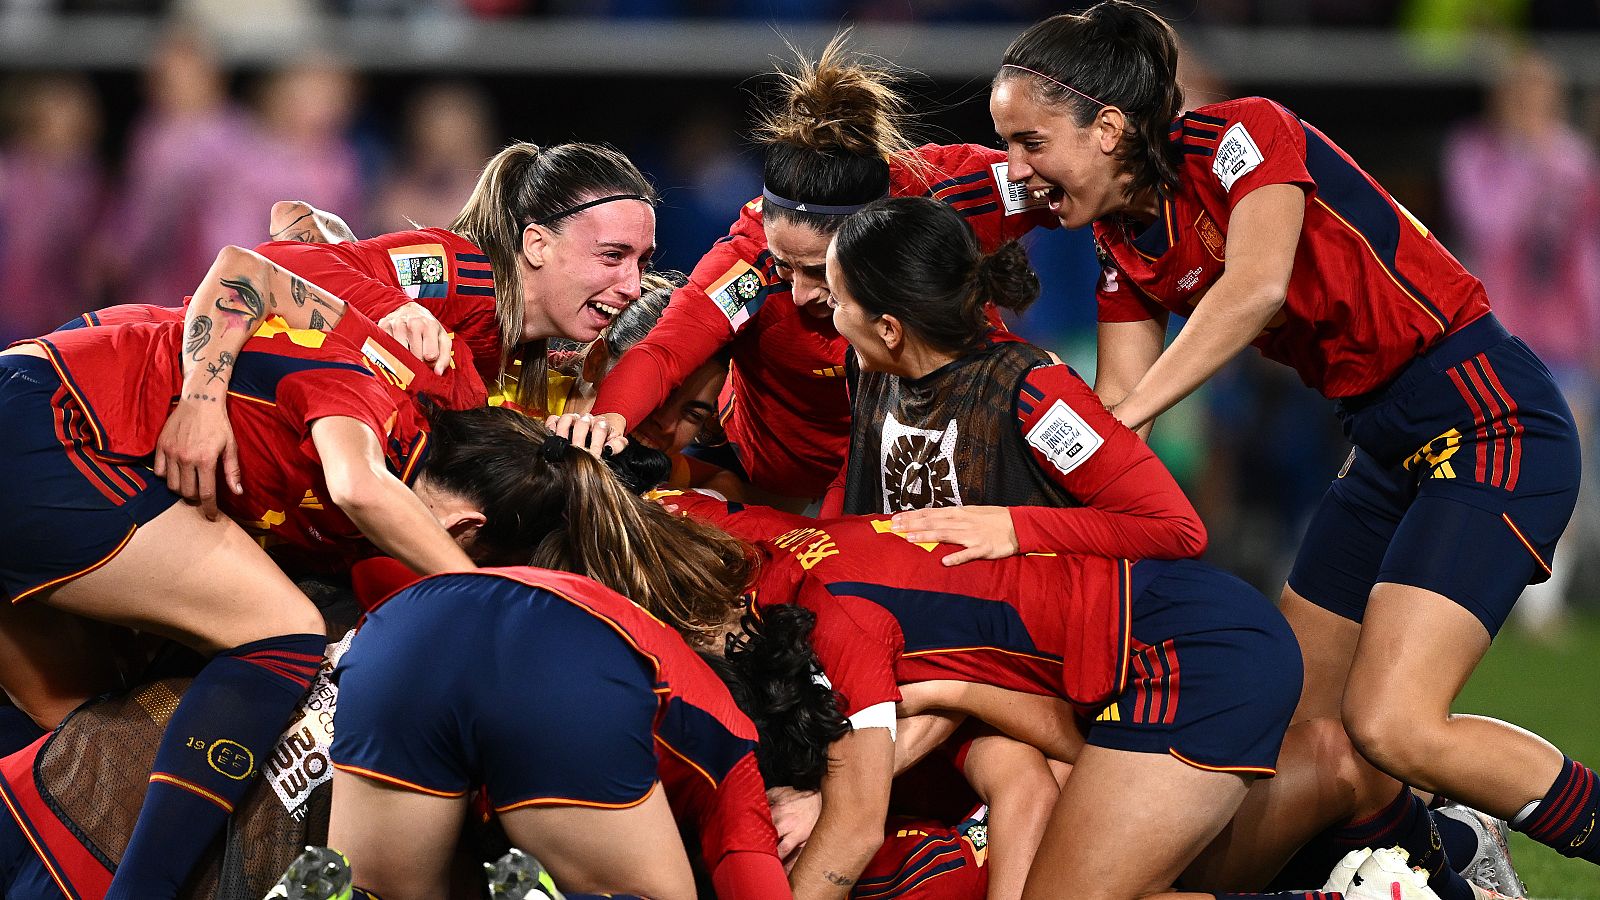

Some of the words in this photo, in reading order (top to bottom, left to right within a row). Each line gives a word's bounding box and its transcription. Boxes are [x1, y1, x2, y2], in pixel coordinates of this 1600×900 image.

[1217, 136, 1238, 159] OOTBALL
[1039, 416, 1065, 443] FOOTBALL
[1045, 422, 1073, 450] UNITES
[1053, 446, 1065, 456] the
[1061, 428, 1082, 449] World
[1067, 444, 1081, 456] FIFA
[186, 736, 206, 750] 19
[290, 803, 310, 824] TM
